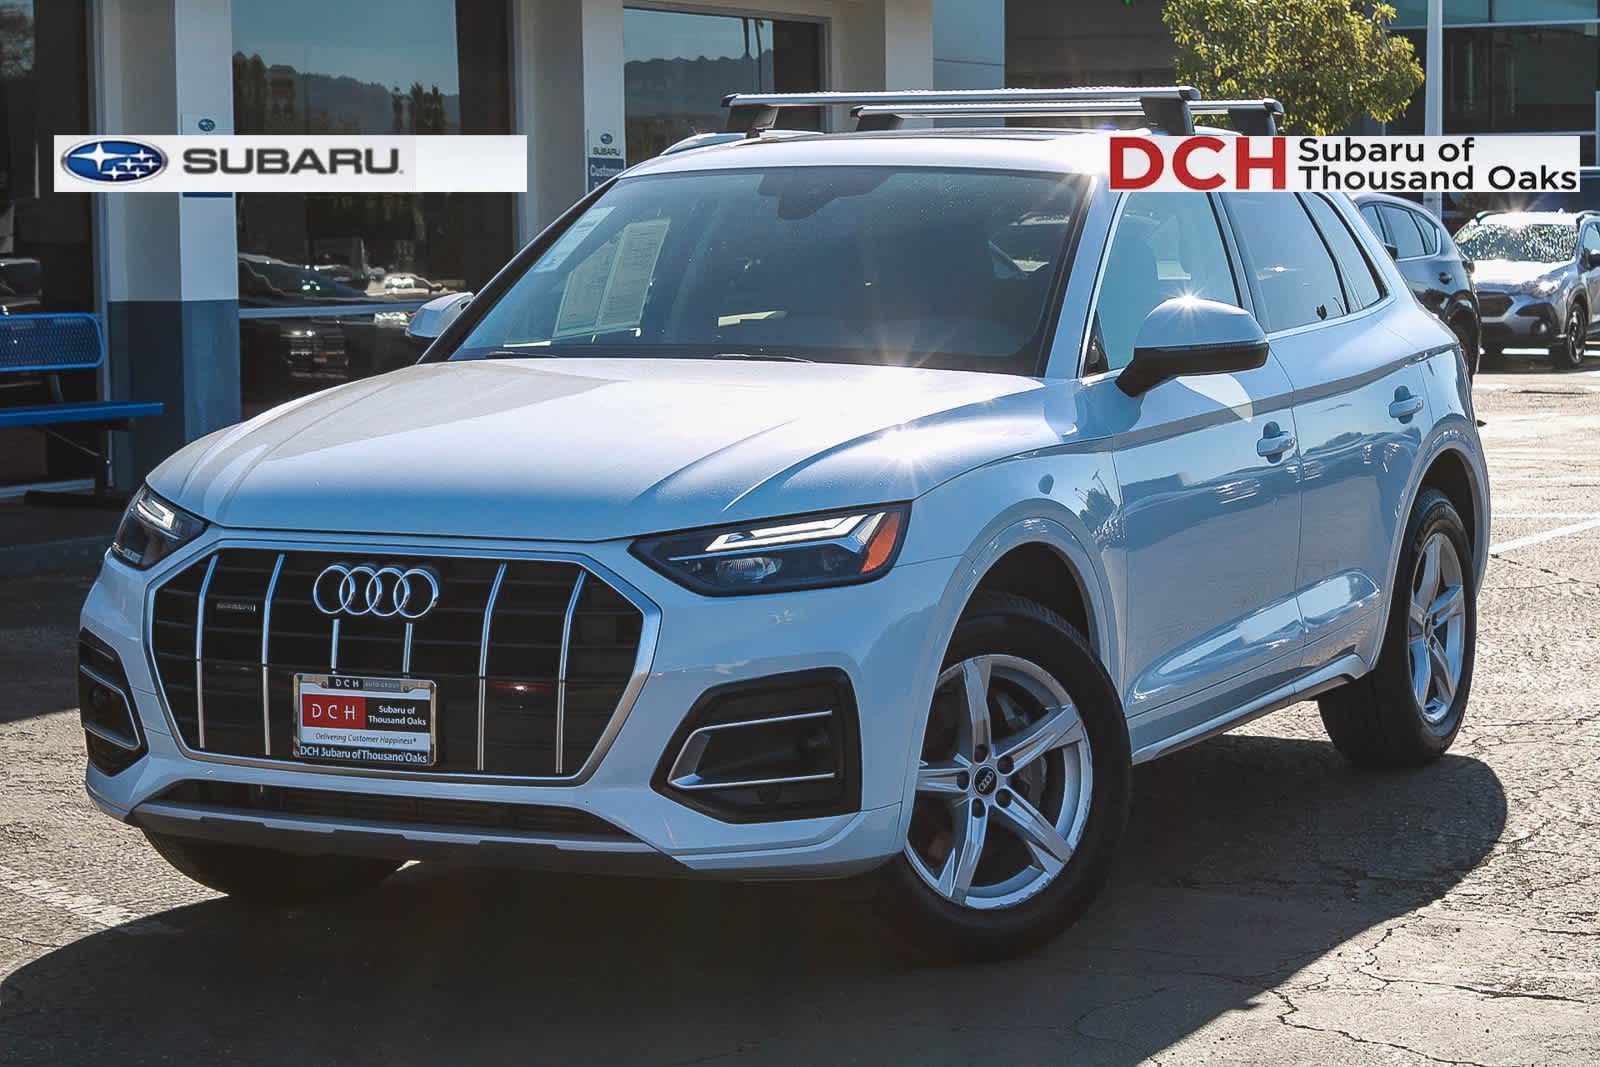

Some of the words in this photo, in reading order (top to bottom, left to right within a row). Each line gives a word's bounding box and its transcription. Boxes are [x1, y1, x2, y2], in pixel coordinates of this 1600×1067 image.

[592, 146, 621, 156] SUBARU
[311, 703, 357, 720] DCH
[378, 705, 406, 714] Subaru
[407, 706, 416, 714] of
[368, 715, 406, 725] Thousand
[406, 717, 427, 726] Oaks
[315, 732, 347, 743] Delivering
[348, 734, 379, 744] Customer
[300, 745, 319, 757] DCH
[320, 747, 351, 759] Subaru
[351, 748, 361, 759] of
[405, 752, 427, 763] Oaks
